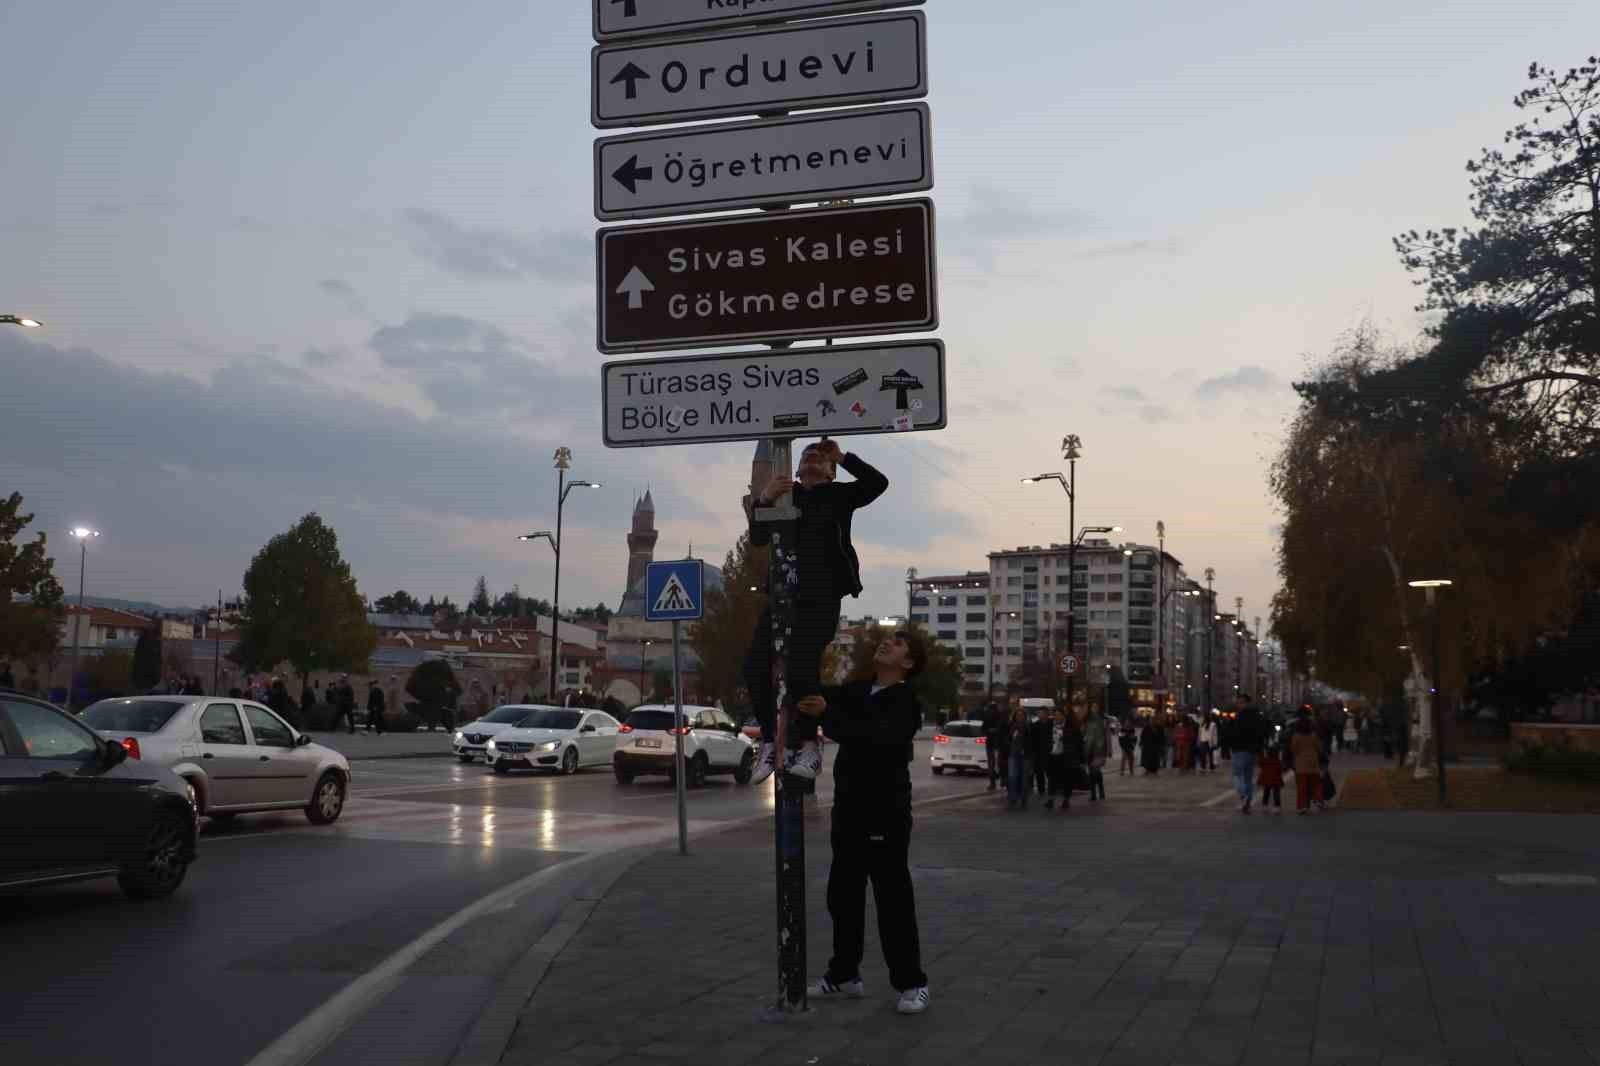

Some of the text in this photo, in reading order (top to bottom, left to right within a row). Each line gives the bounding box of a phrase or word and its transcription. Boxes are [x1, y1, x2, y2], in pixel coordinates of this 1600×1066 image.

[662, 41, 875, 93] Orduevi
[664, 139, 906, 187] Öğretmenevi
[667, 230, 904, 273] Sivas Kalesi
[667, 282, 916, 320] Gökmedrese
[621, 373, 732, 396] Türasaş
[742, 365, 820, 389] Sivas
[710, 400, 760, 425] Md.
